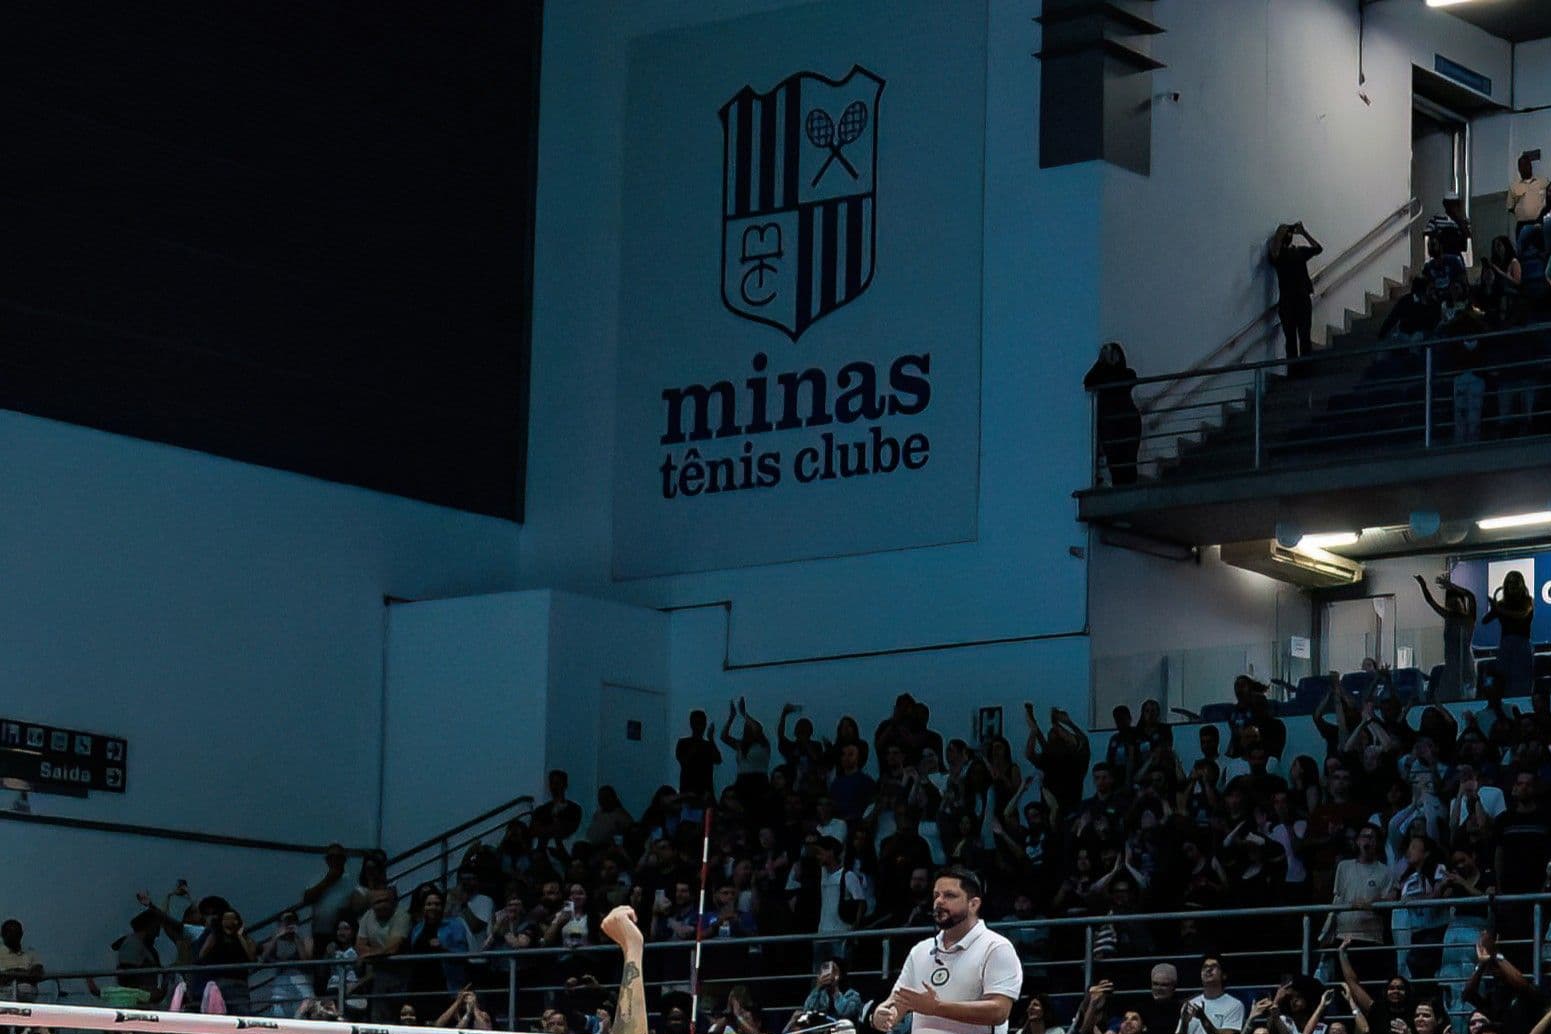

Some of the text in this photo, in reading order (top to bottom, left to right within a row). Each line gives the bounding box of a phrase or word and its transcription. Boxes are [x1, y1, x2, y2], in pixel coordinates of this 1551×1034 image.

[660, 352, 932, 446] minas
[660, 426, 931, 500] tênis clube
